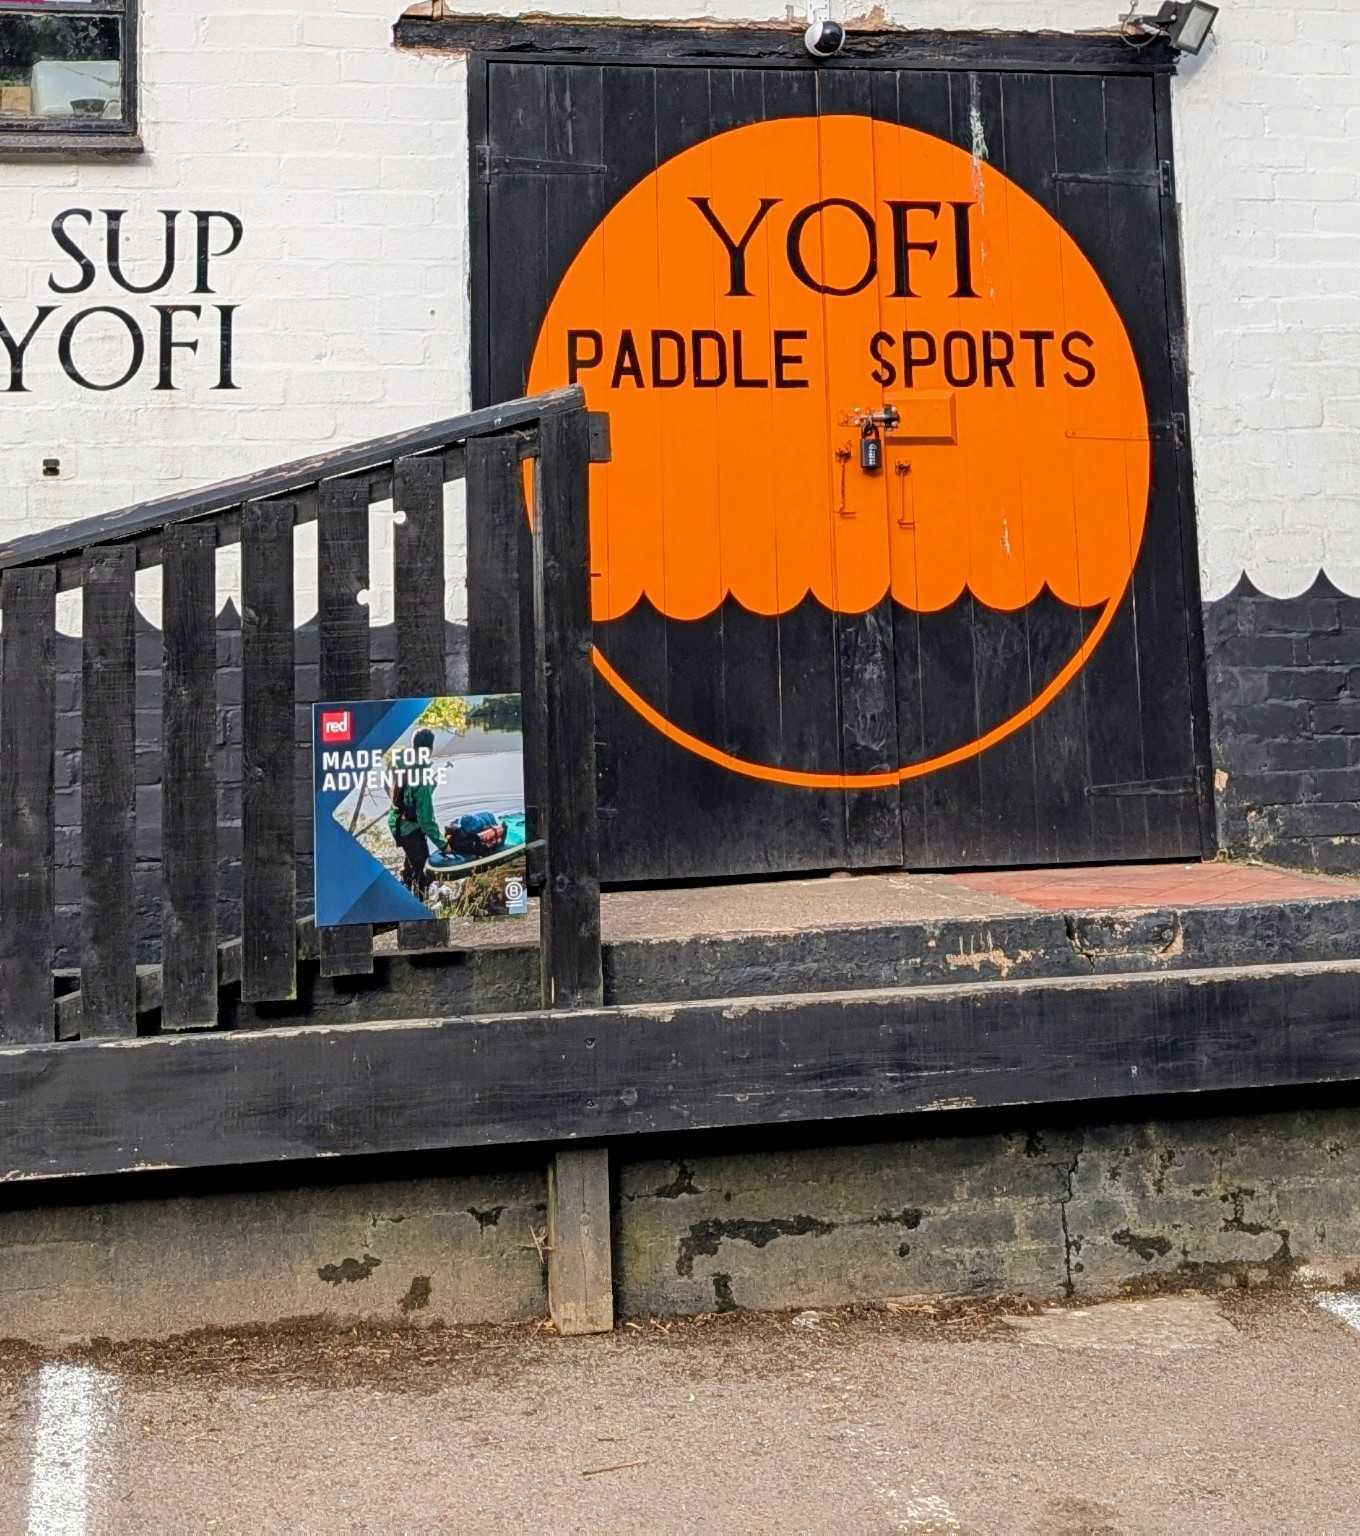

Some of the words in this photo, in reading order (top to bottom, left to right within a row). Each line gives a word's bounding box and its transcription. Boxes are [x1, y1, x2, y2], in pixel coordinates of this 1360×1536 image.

[47, 208, 244, 294] SUP
[687, 196, 983, 299] YOFI
[567, 328, 809, 389] PADDLE
[869, 329, 1097, 389] SPORTS
[325, 711, 349, 733] red
[322, 749, 383, 770] MADE
[391, 746, 431, 767] FOR
[322, 767, 448, 792] ADVENTURE
